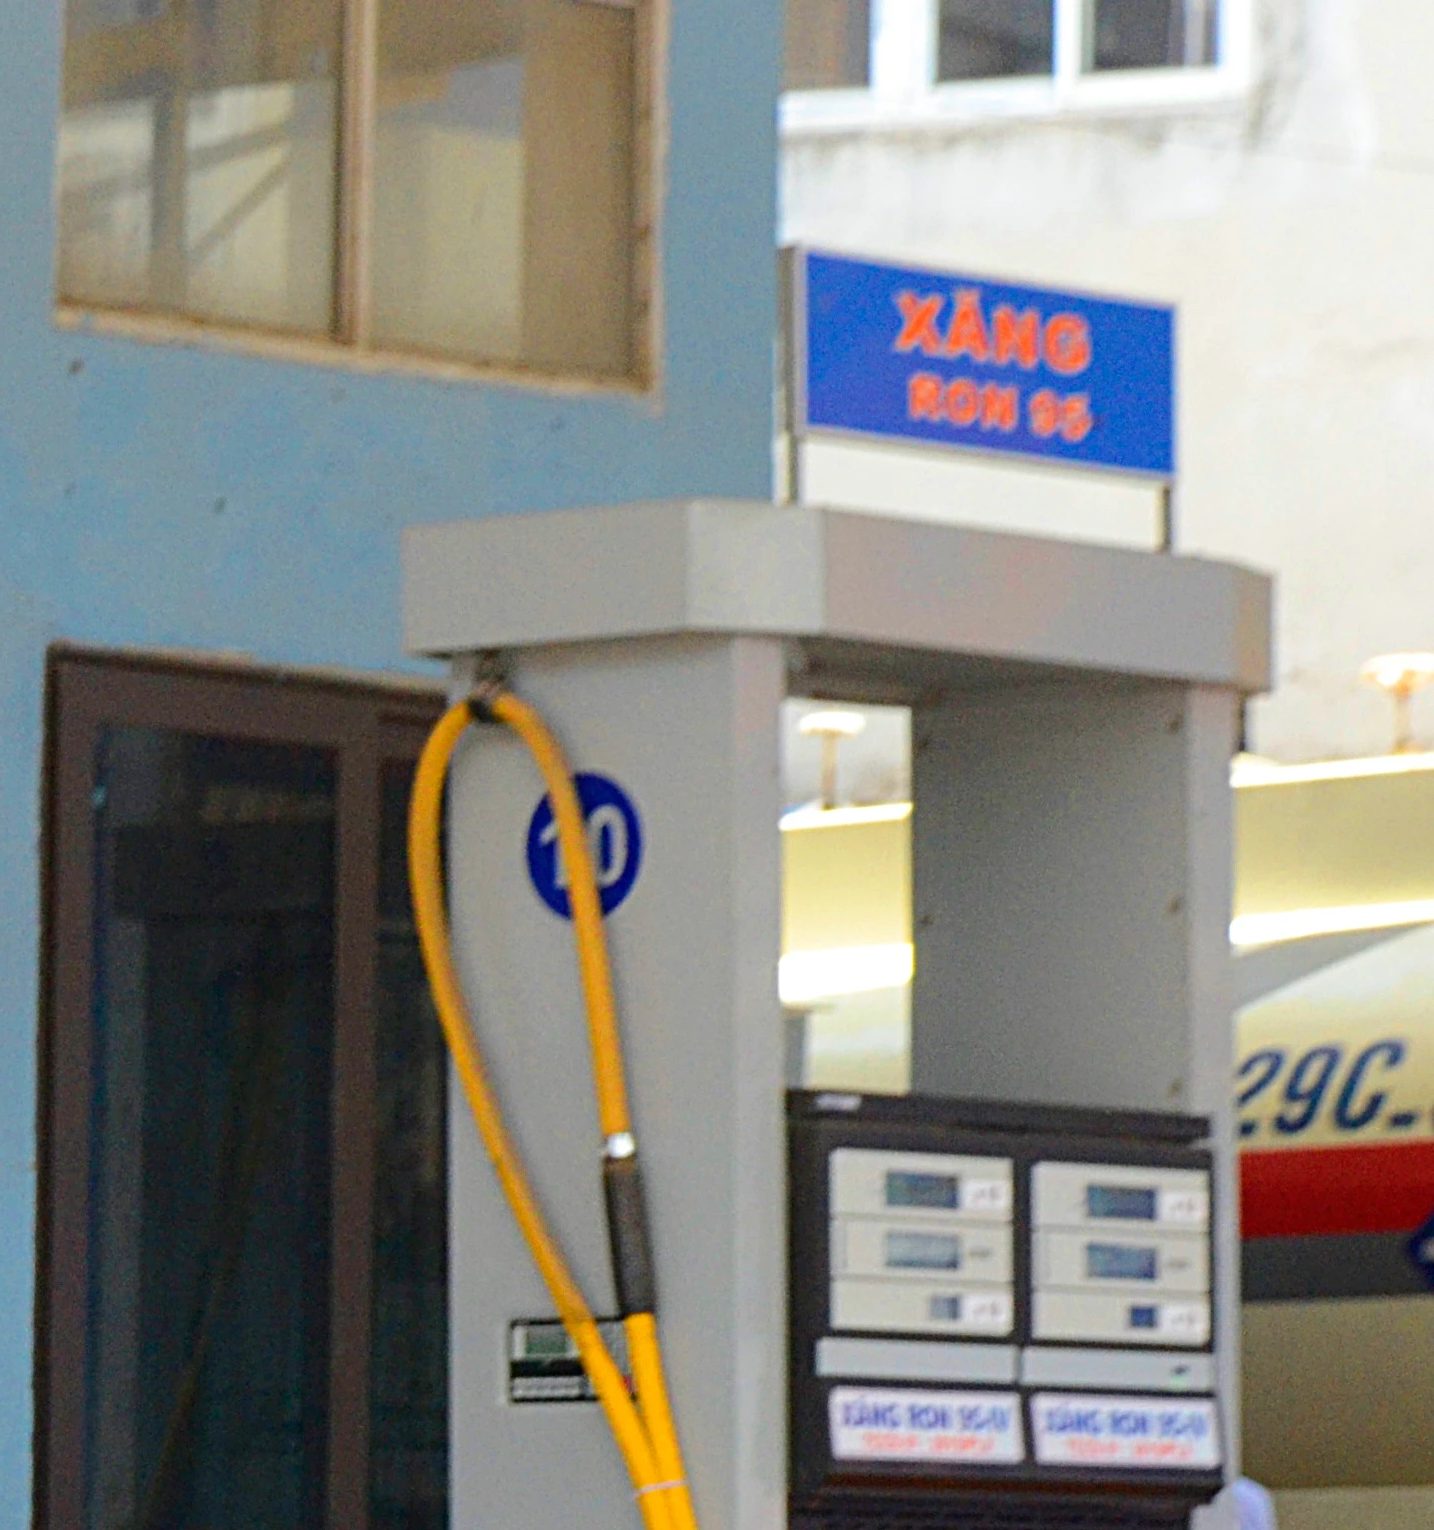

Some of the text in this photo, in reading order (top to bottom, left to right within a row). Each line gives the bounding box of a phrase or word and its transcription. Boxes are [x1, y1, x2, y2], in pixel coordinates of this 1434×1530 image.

[894, 289, 1091, 375] XĂNG
[907, 371, 1093, 442] RON 95
